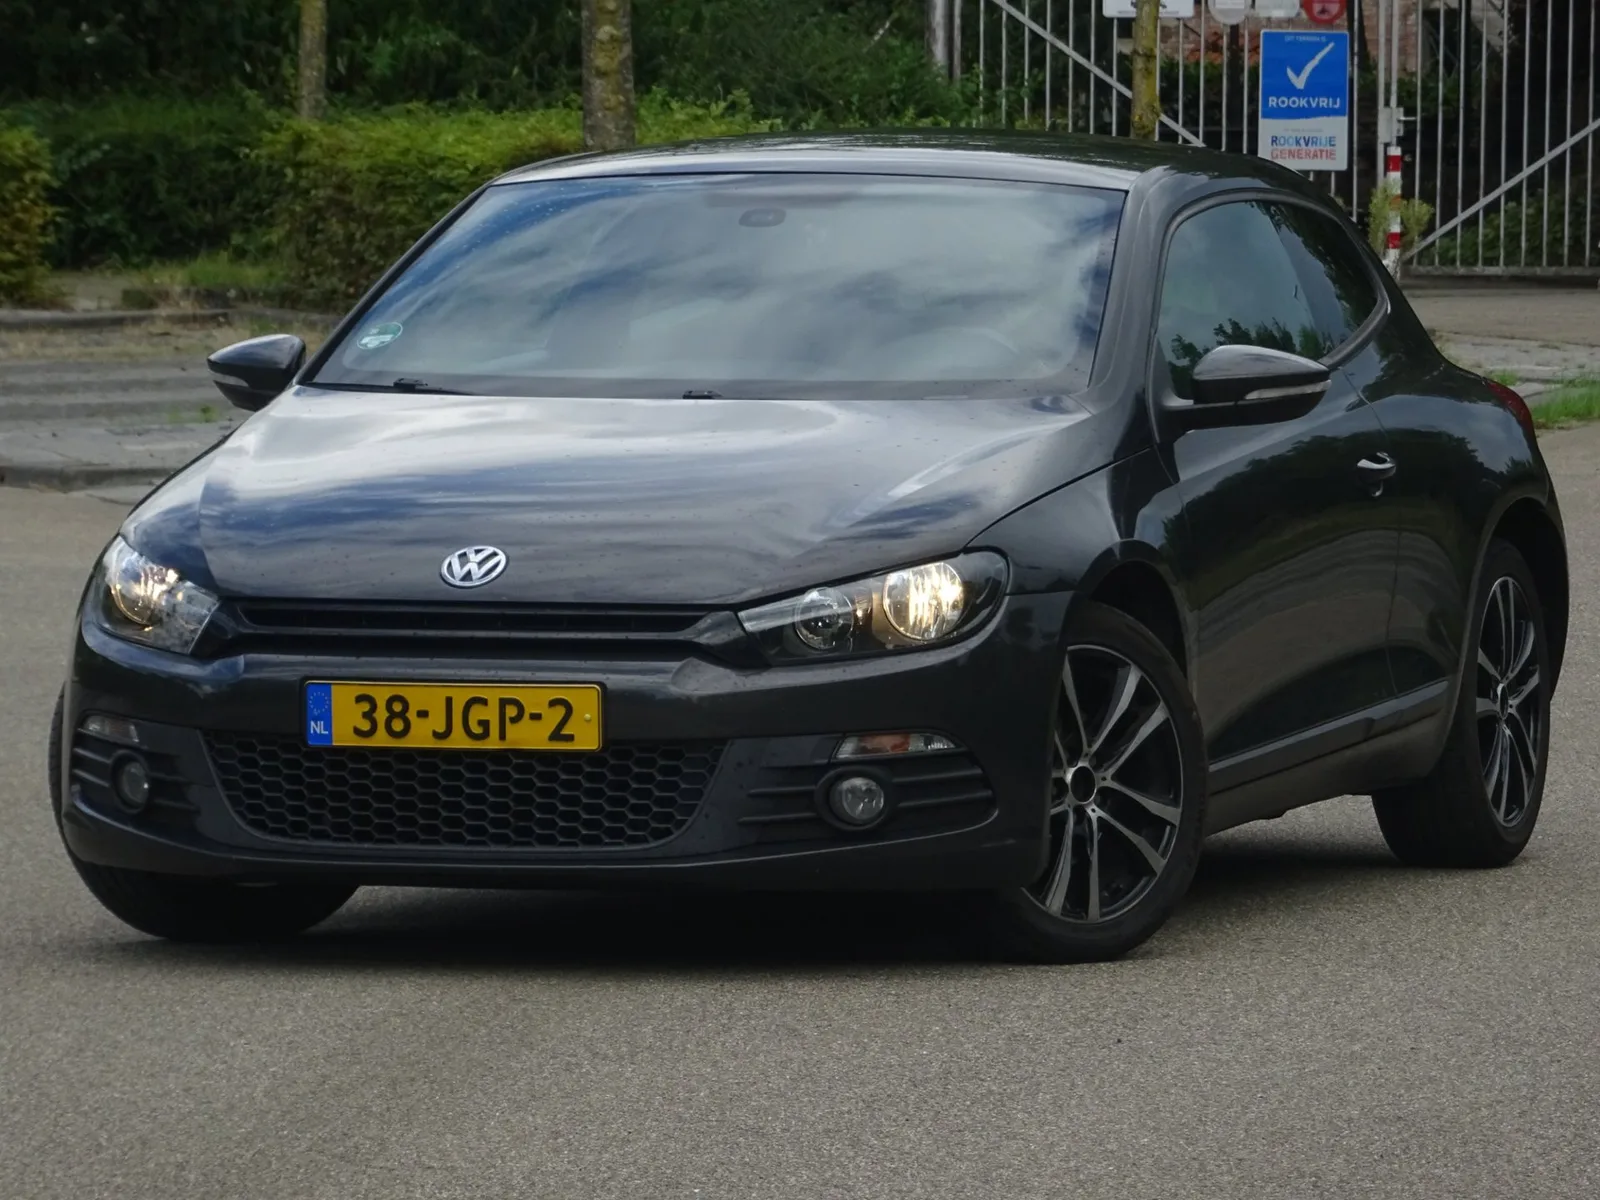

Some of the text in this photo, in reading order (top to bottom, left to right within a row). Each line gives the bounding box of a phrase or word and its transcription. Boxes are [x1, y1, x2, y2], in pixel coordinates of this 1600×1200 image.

[1268, 96, 1340, 109] ROOKVRIJ
[1271, 135, 1337, 147] ROOKVRIJE
[1271, 148, 1337, 160] GENERATIE
[352, 693, 576, 743] 38-JGP-2
[309, 720, 329, 735] NL
